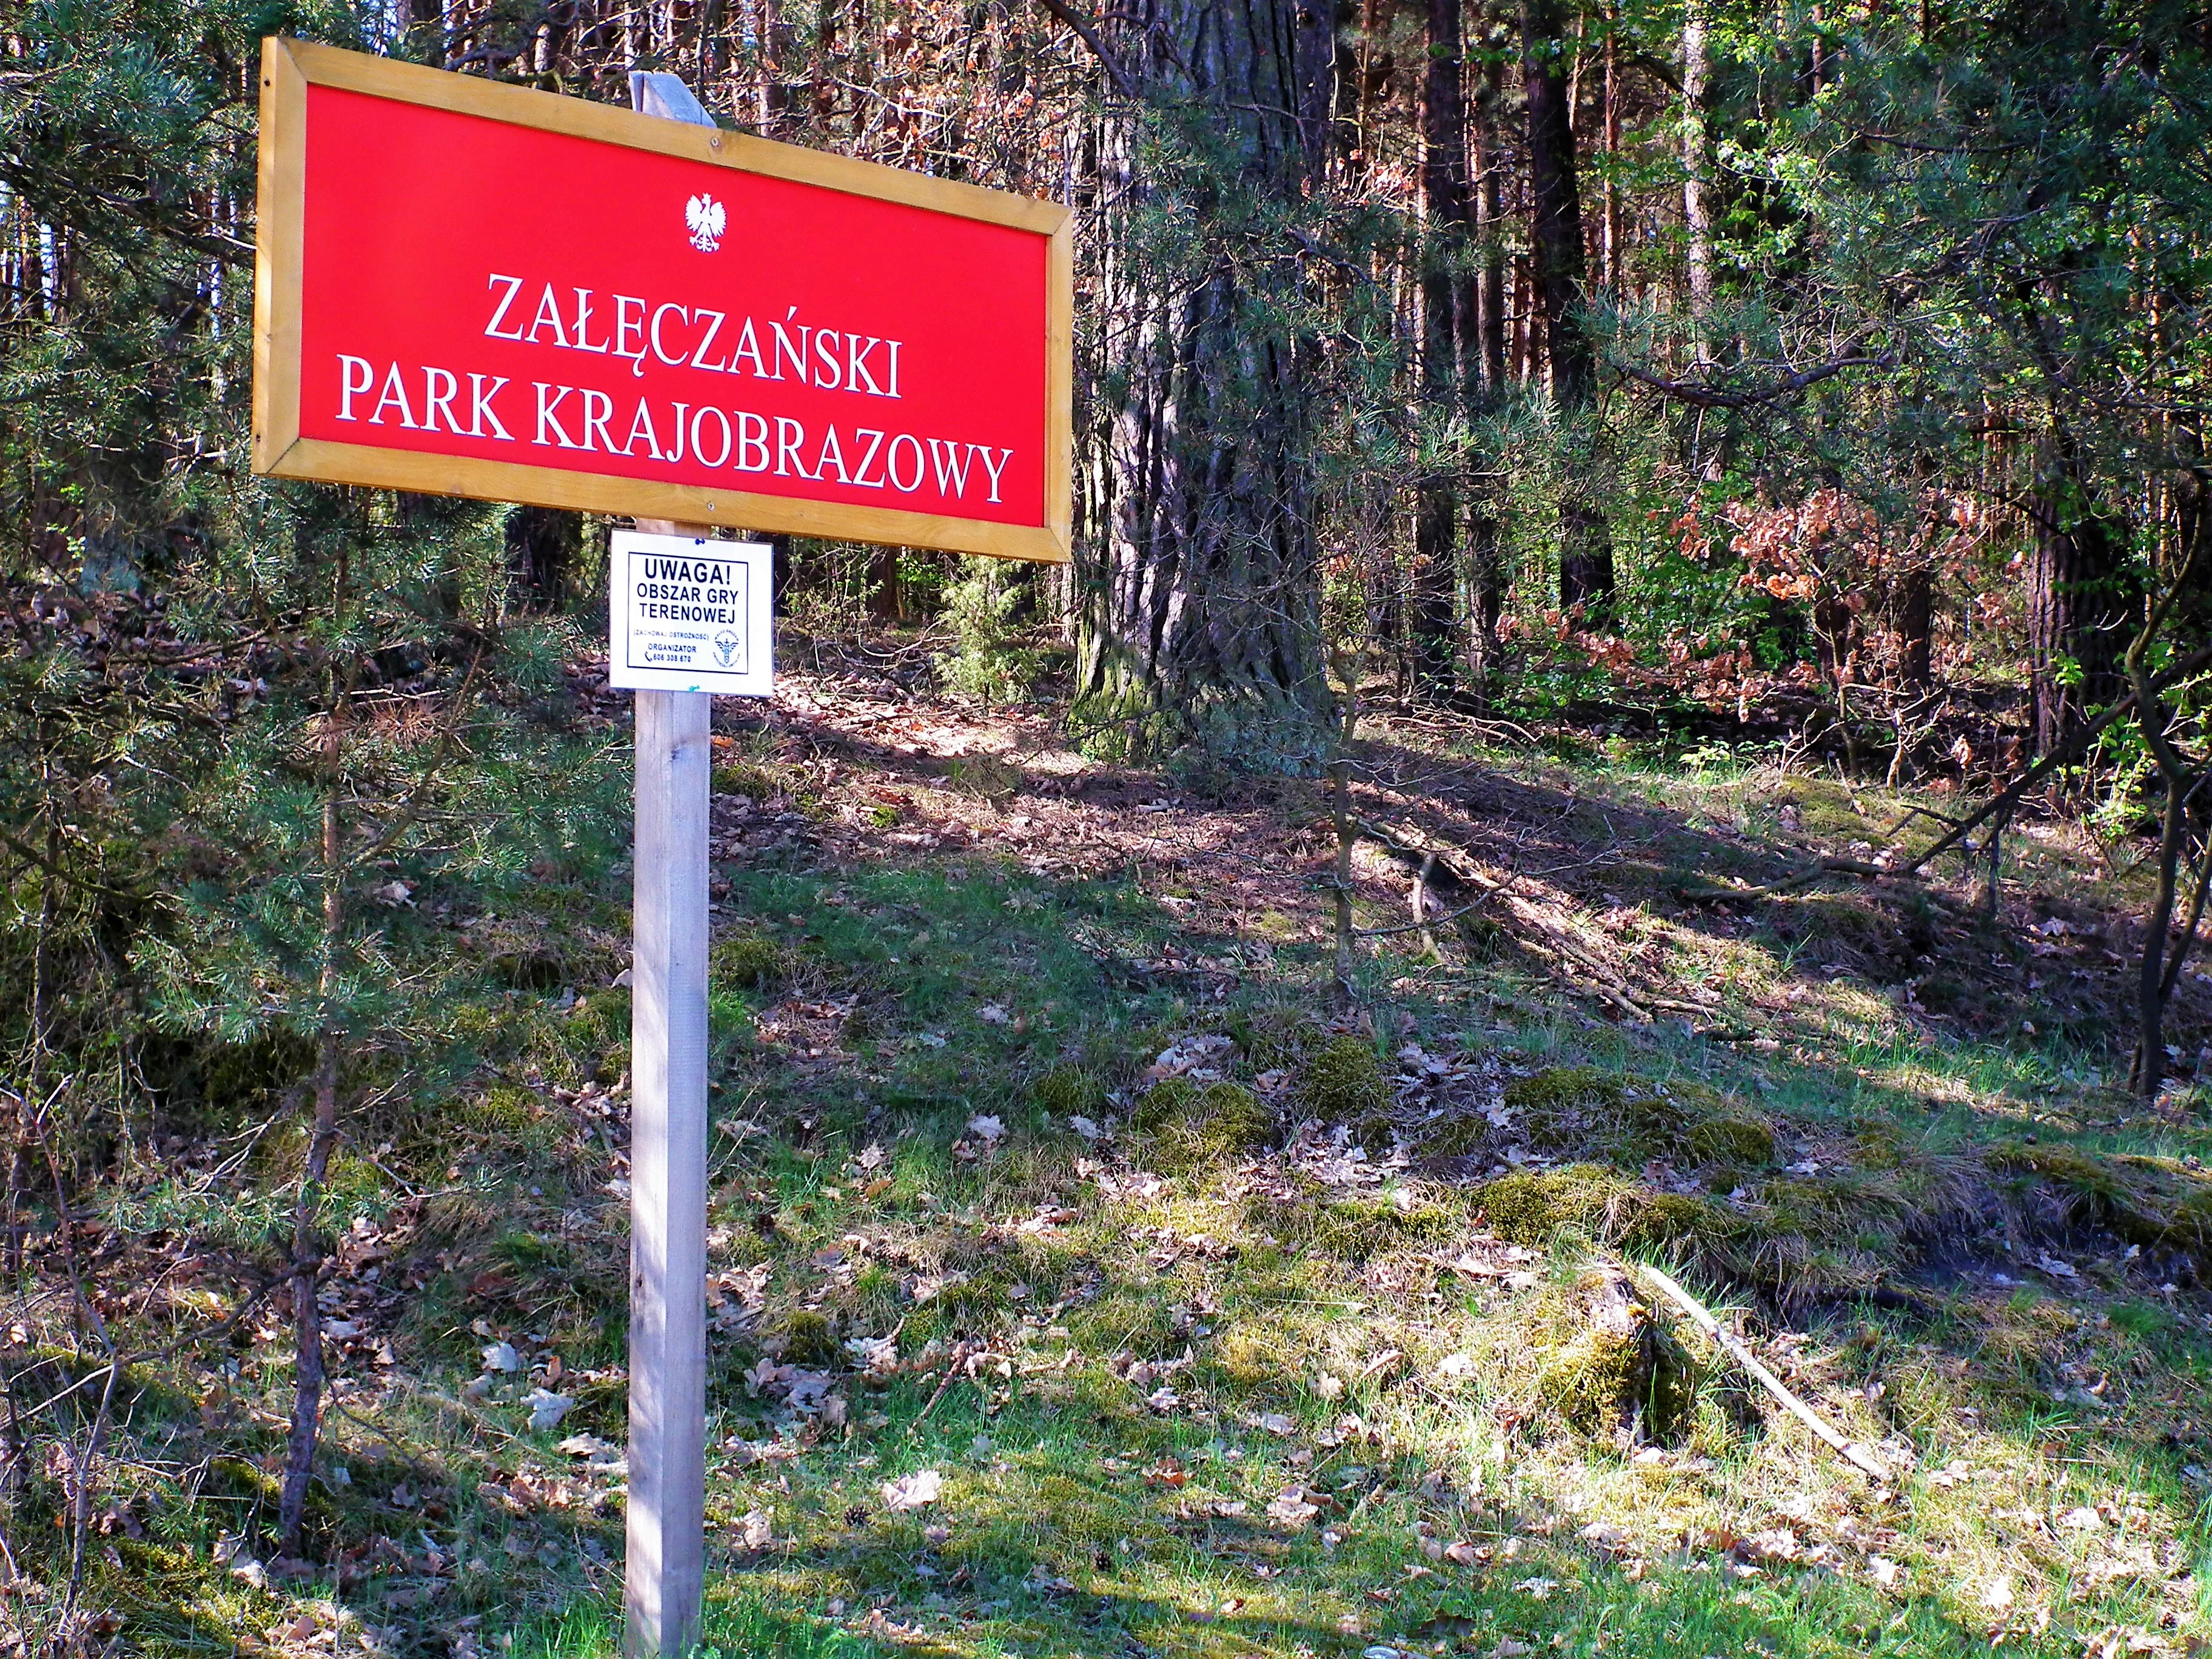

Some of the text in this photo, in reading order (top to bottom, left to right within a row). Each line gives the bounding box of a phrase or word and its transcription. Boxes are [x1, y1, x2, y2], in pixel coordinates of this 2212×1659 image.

[484, 273, 902, 398] ZAŁĘCZAŃSKI
[335, 354, 1013, 503] PARK KRAJOBRAZOWY
[645, 558, 731, 585] UWAGA!
[637, 583, 739, 605] OBSZAR GRY
[639, 603, 735, 624] TERENOWEJ
[648, 643, 697, 653] ORGANIZATOR
